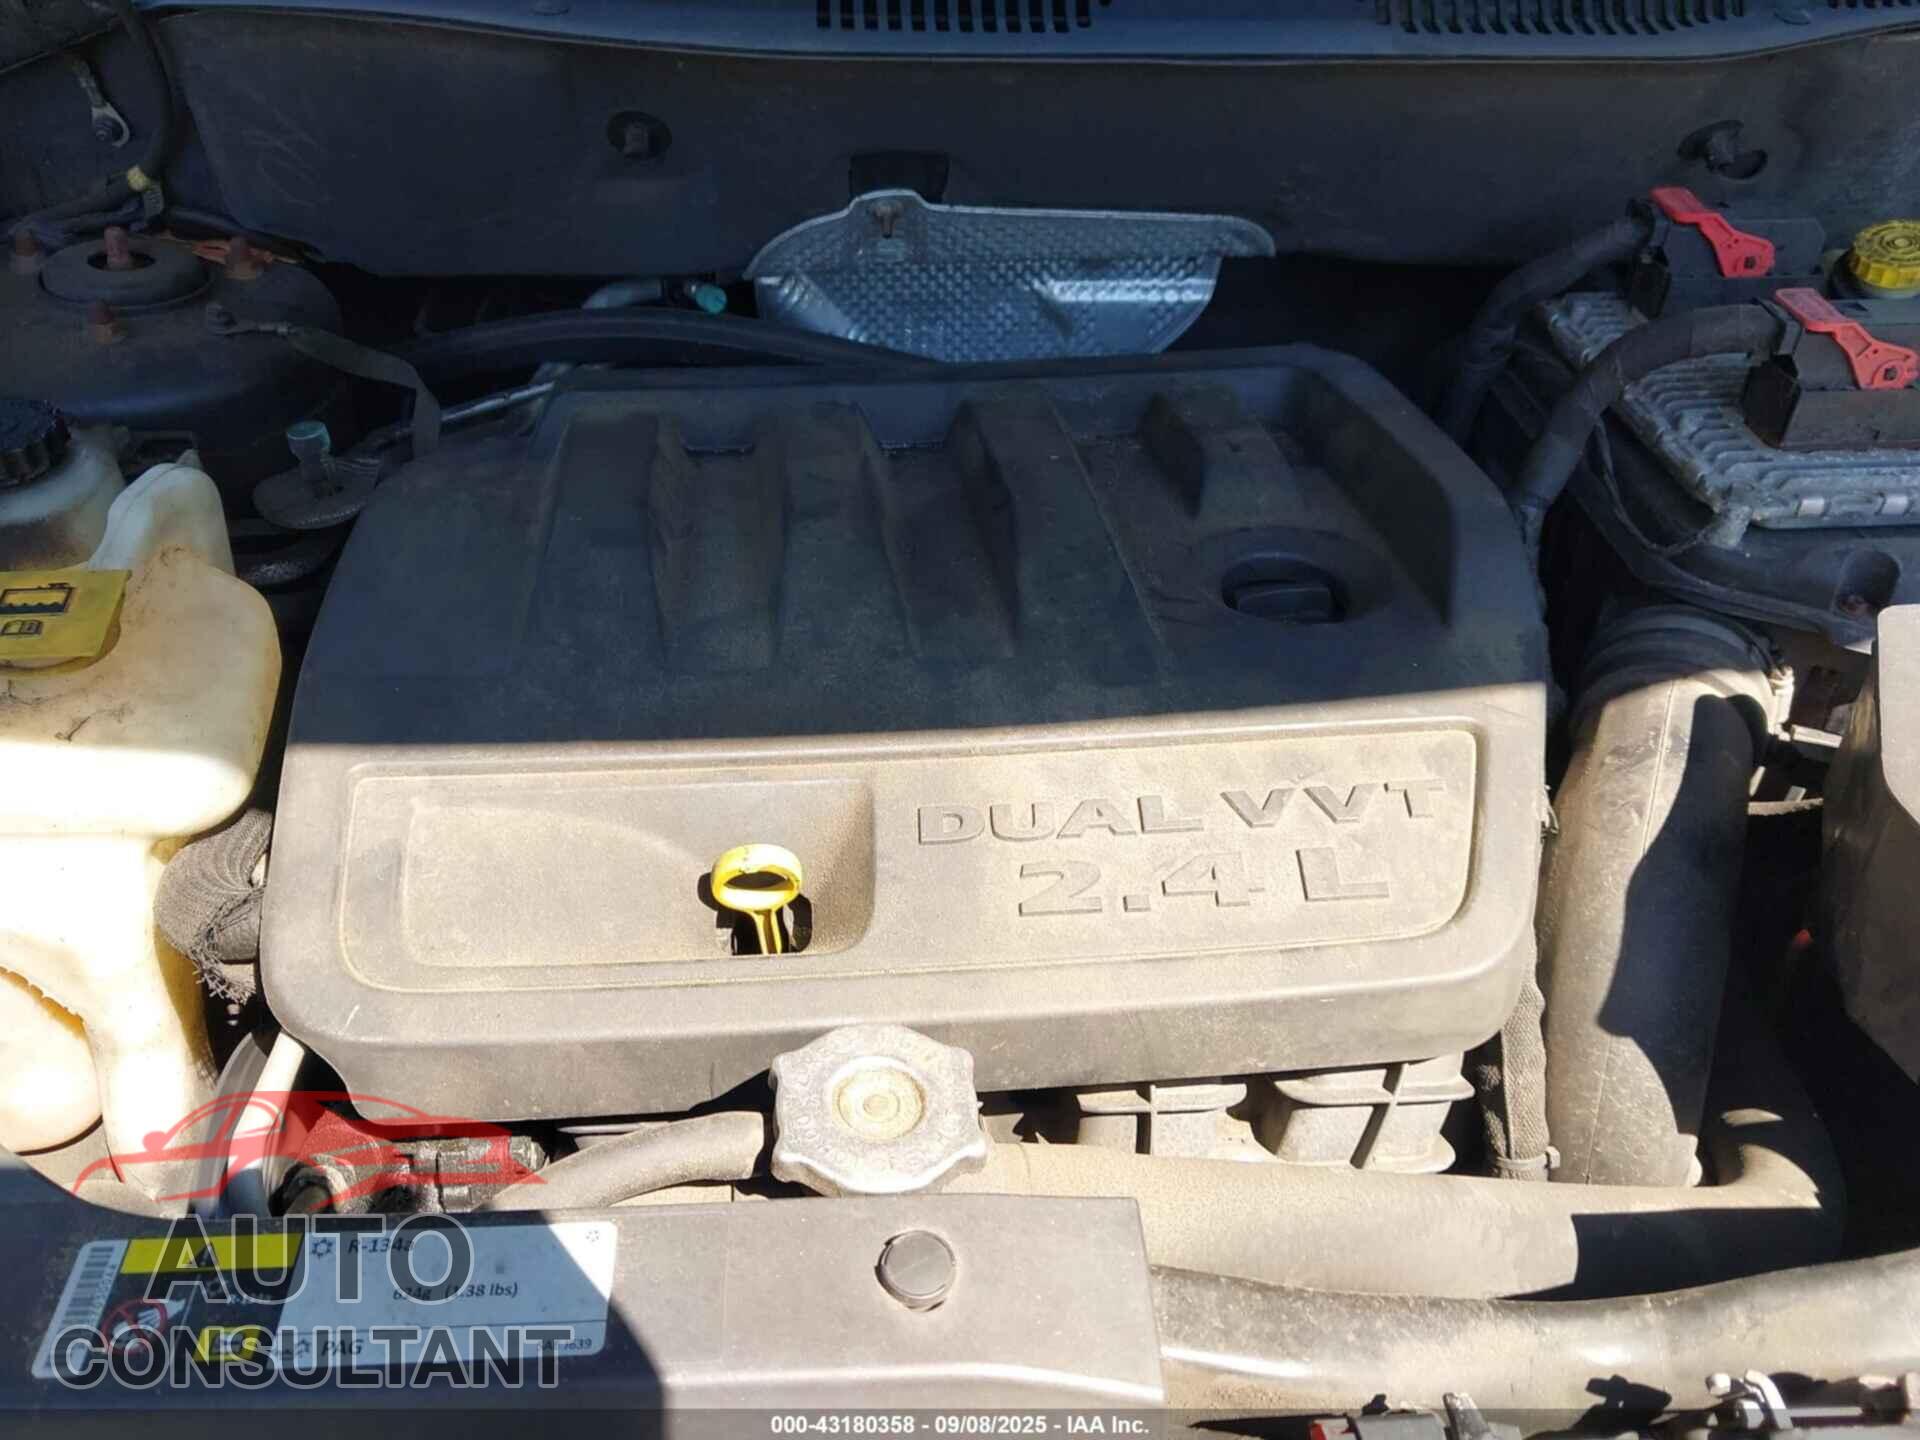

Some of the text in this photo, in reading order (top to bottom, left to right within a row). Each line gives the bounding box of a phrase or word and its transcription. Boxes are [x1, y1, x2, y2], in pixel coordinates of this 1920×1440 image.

[917, 779, 1444, 845] DUAL VVT
[1018, 847, 1390, 917] 2.4 L
[489, 1281, 518, 1299] lbs)
